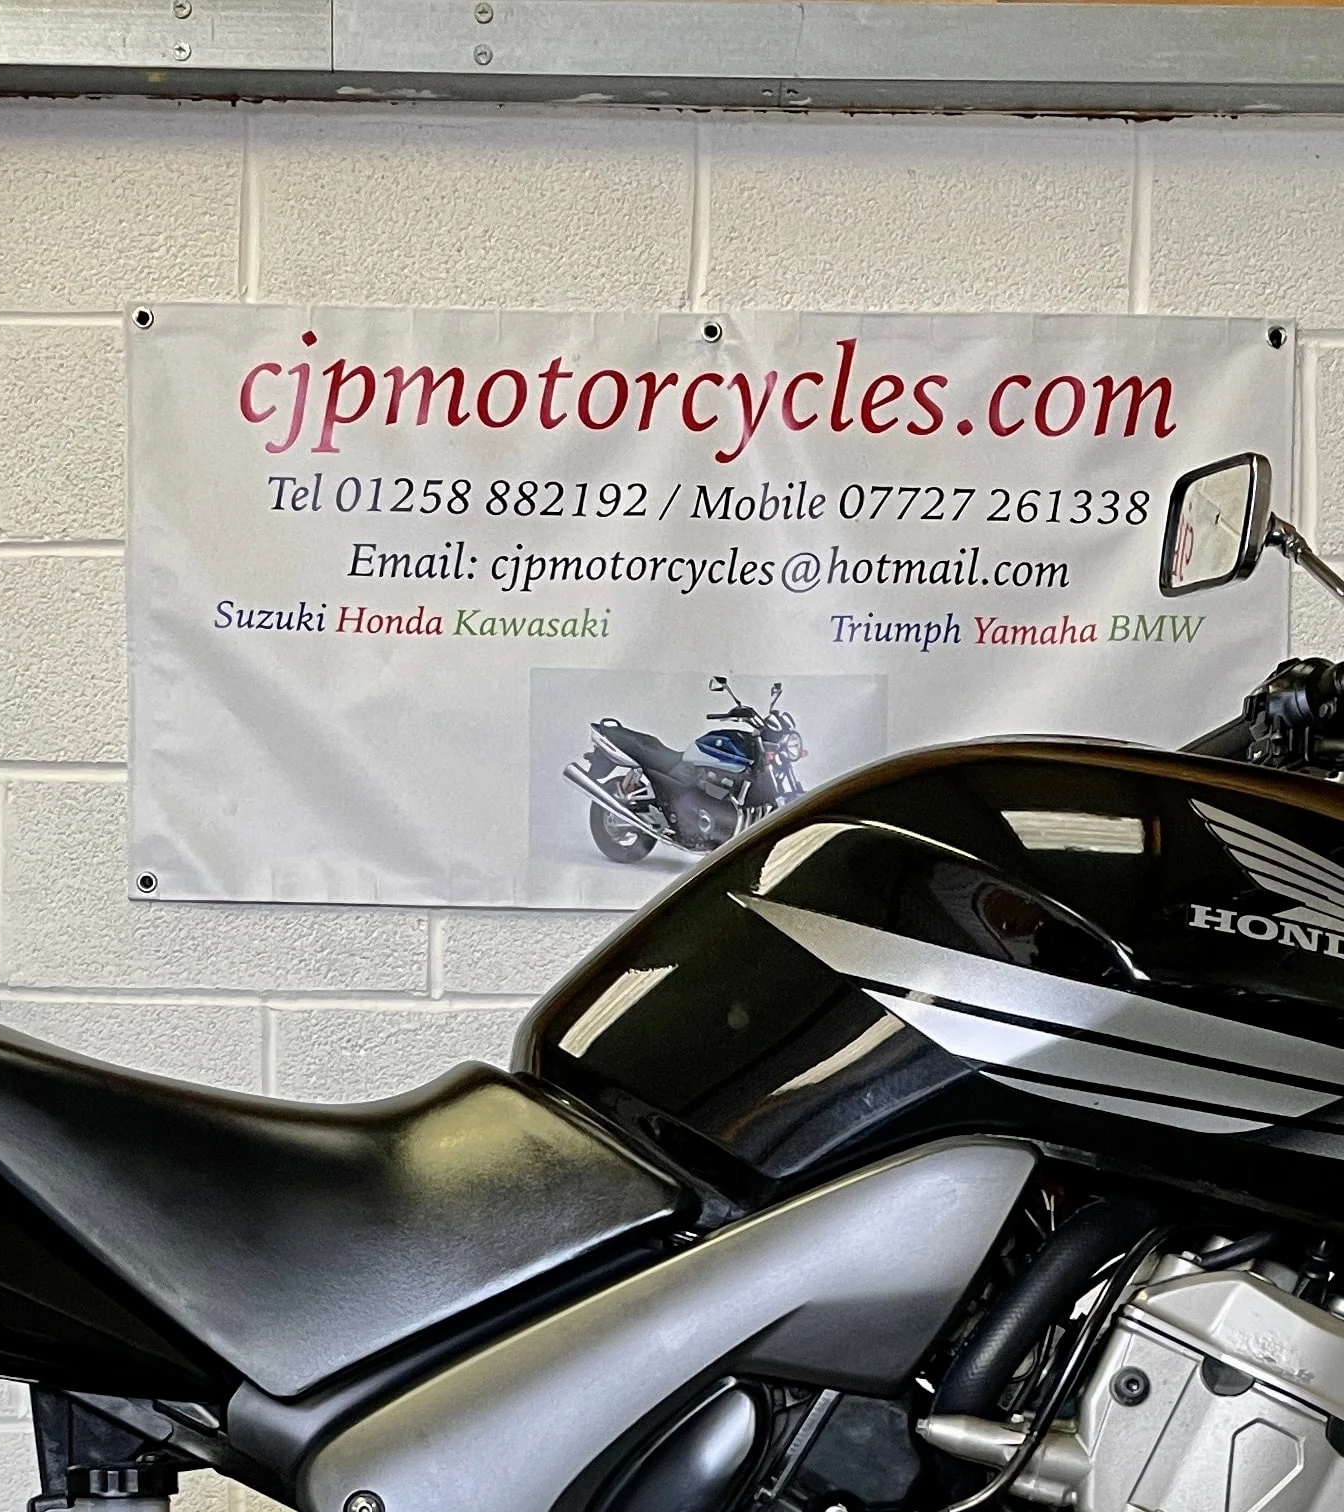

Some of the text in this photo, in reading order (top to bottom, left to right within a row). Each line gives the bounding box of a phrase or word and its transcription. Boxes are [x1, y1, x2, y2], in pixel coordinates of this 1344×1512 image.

[238, 329, 1178, 465] cjpmotorcycles.com
[267, 473, 1150, 525] Tel 01258 882192 / Mobile 07727 261338
[346, 541, 1070, 595] Email: cjpmotorcycles@hotmail.com
[214, 601, 612, 638] Suzuki Honda Kawasaki
[830, 612, 1206, 652] Triumph Yamaha BMW
